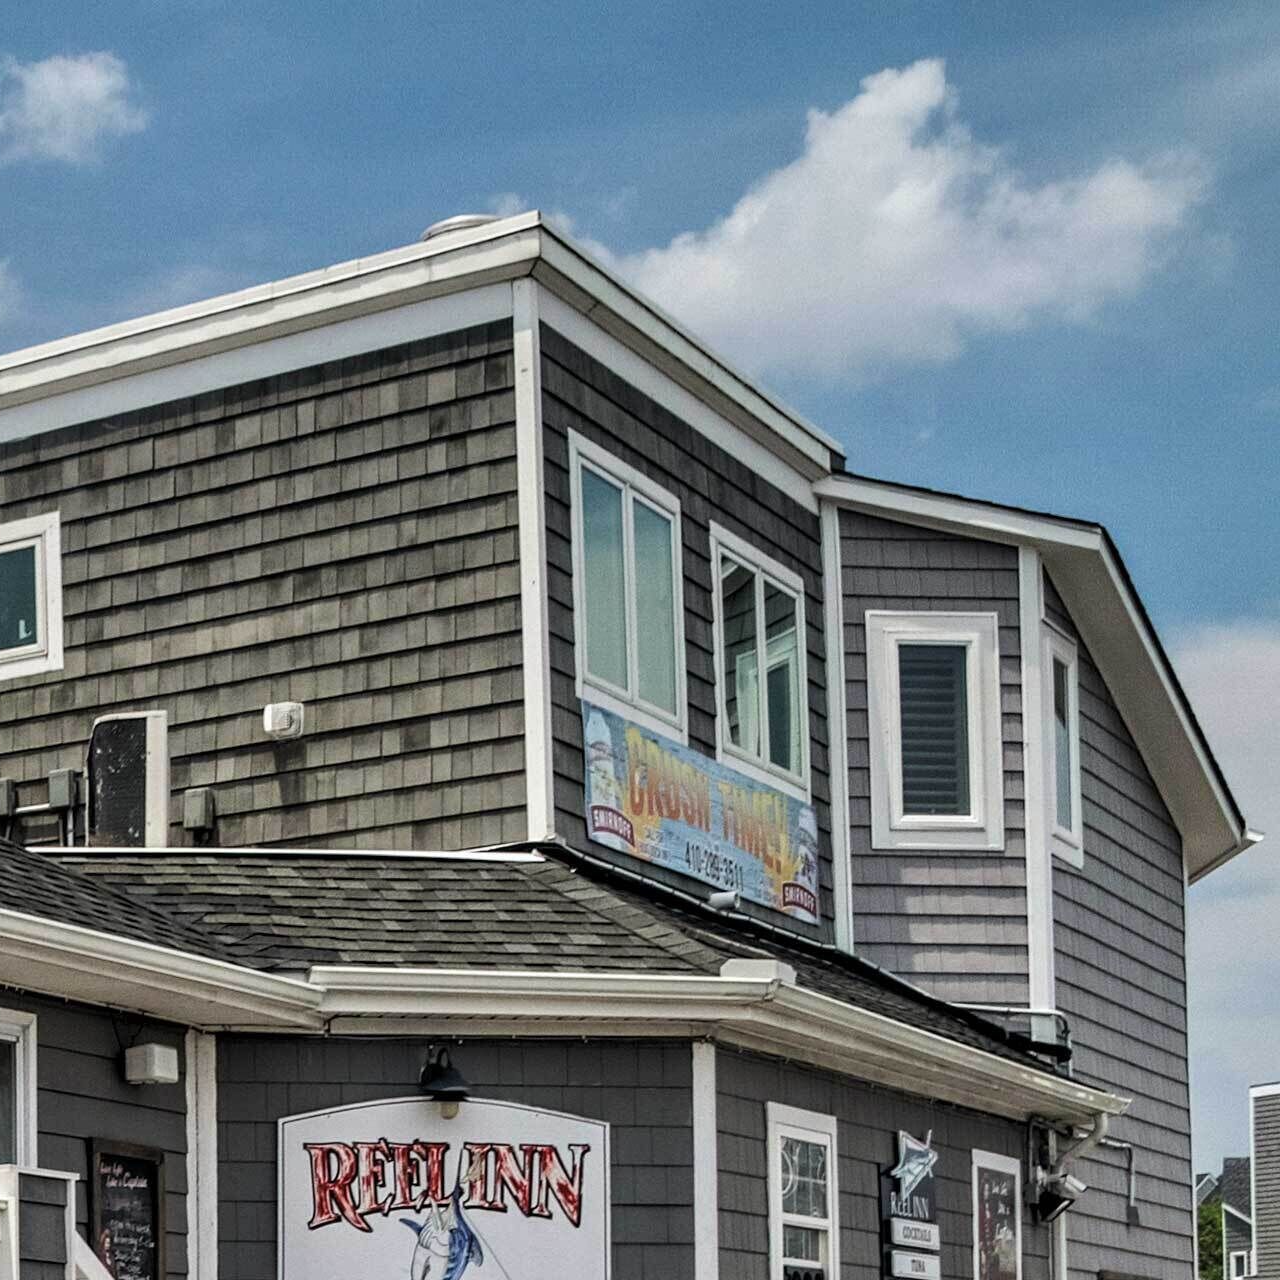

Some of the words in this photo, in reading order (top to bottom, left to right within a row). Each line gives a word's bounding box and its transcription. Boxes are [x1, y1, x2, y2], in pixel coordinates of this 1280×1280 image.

[594, 808, 633, 839] SMIRNOFF
[785, 886, 815, 910] SMIRNOFF
[303, 1137, 455, 1233] REEL
[462, 1142, 591, 1229] INN
